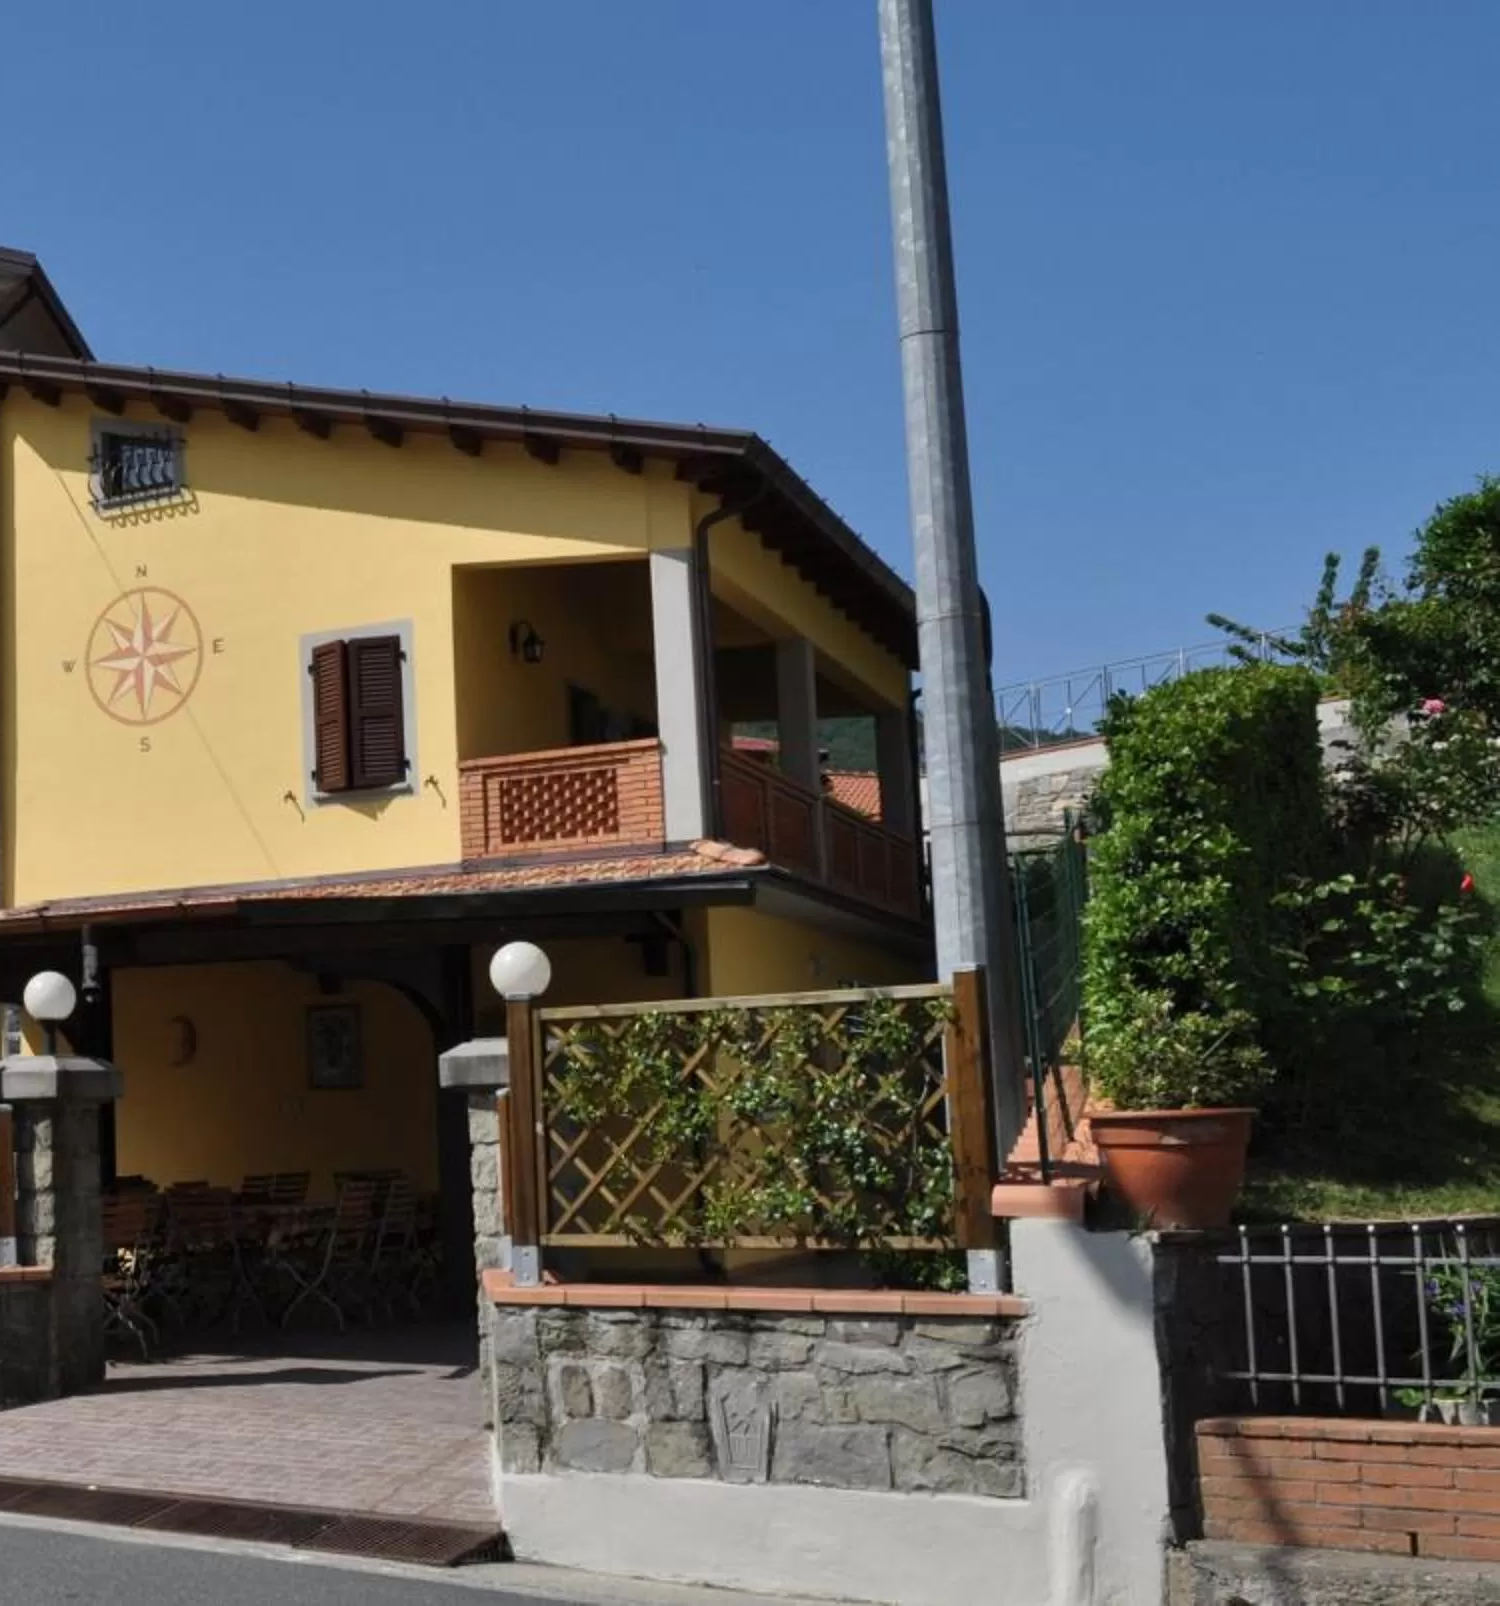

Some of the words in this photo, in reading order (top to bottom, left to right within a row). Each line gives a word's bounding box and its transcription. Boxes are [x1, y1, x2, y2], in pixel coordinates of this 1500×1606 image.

[135, 564, 148, 578] N
[212, 638, 225, 655] E
[61, 659, 77, 673] W
[138, 736, 152, 753] S
